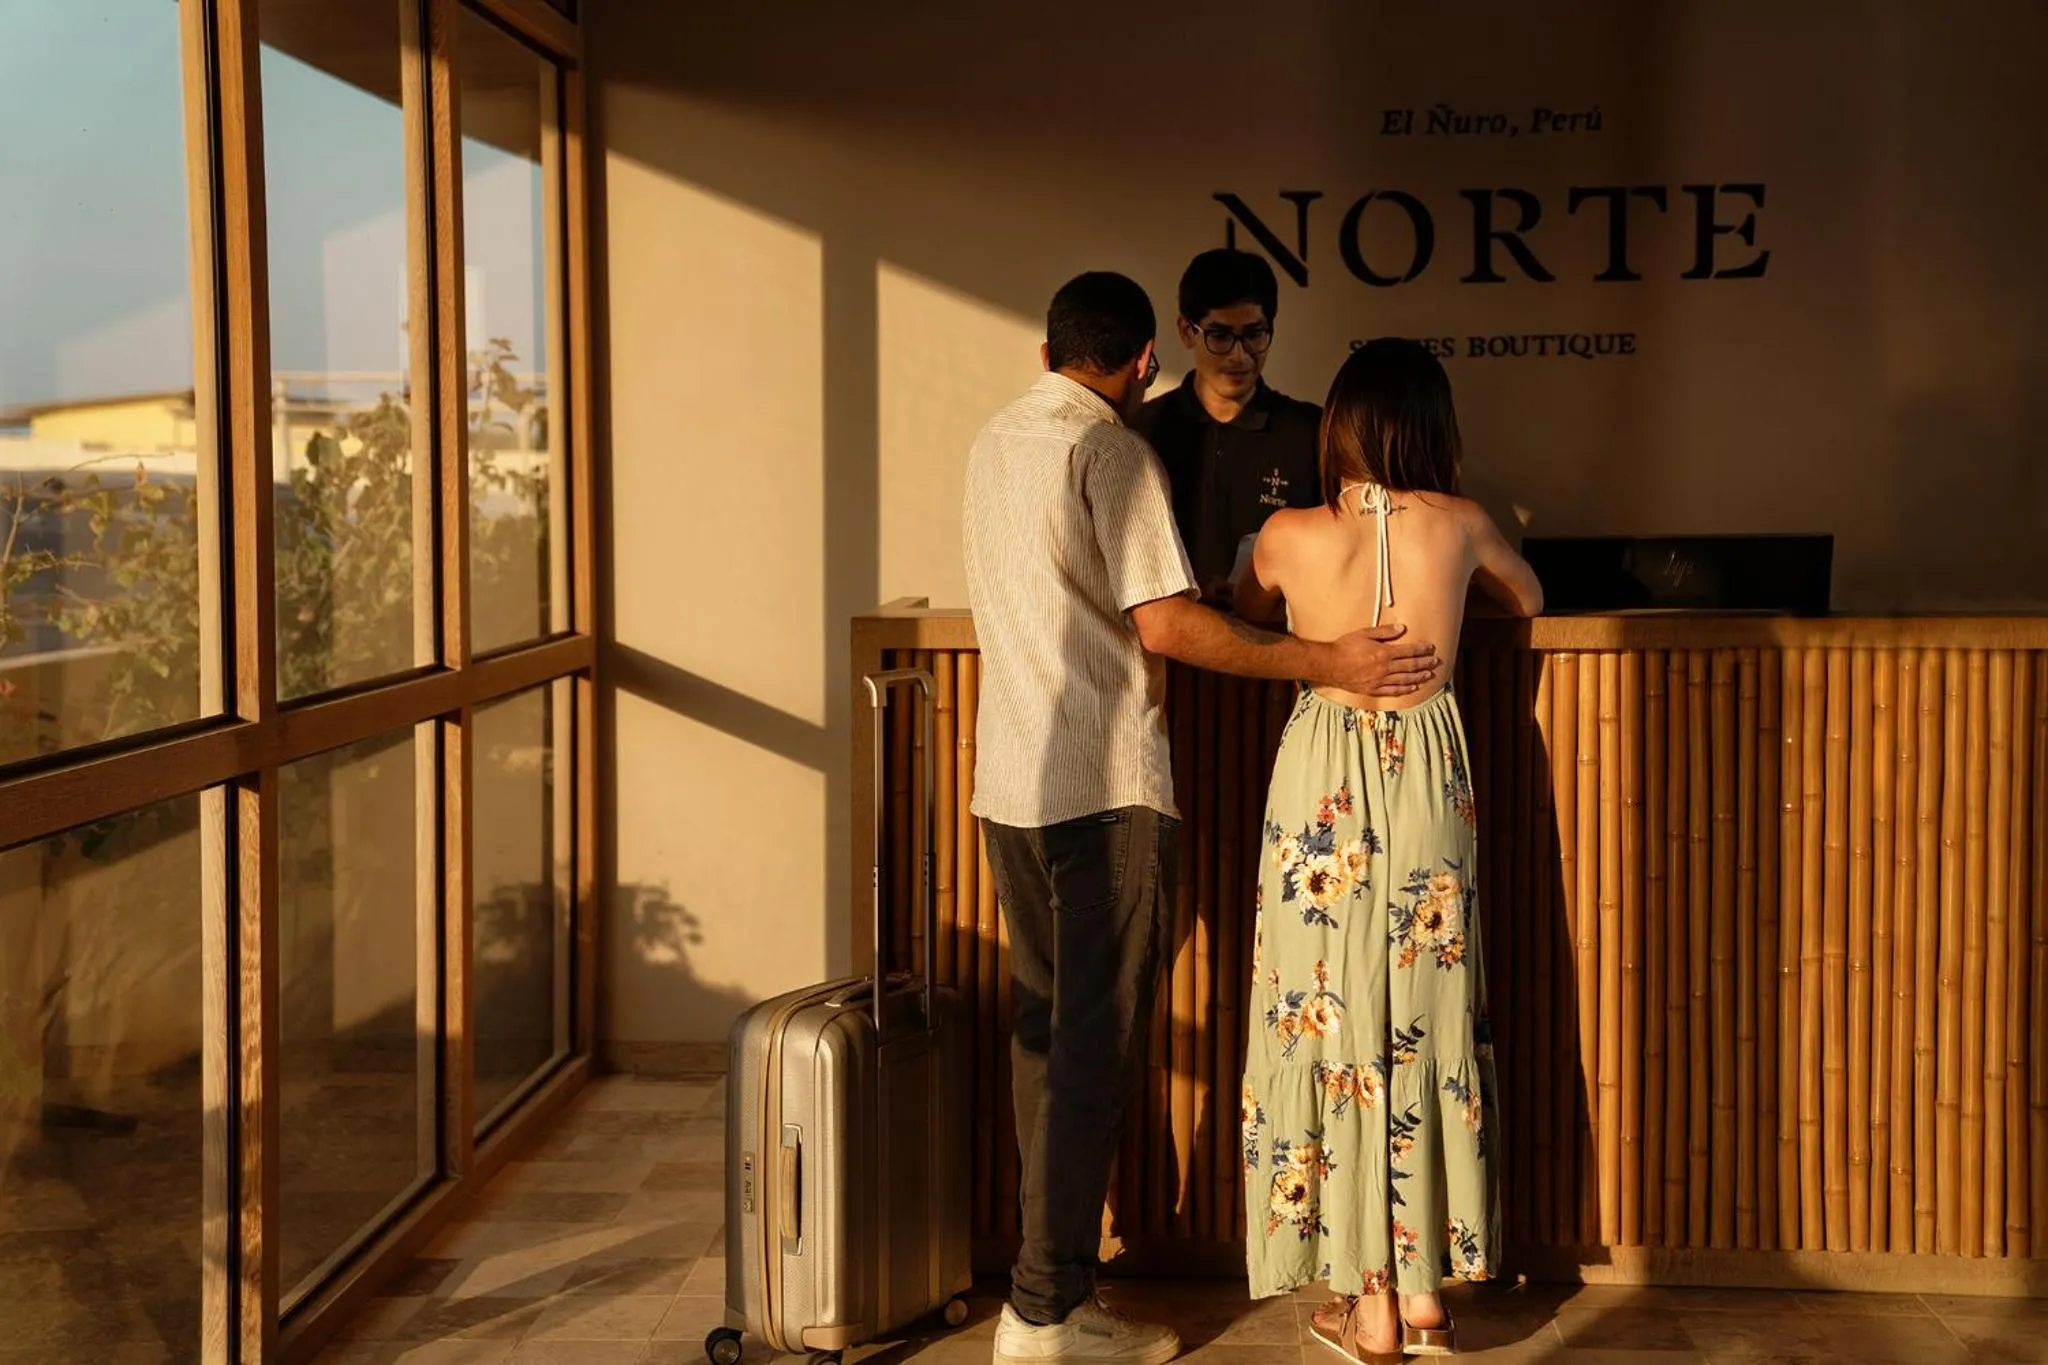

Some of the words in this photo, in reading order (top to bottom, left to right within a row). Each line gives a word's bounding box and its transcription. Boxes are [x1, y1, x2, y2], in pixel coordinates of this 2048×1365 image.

[1381, 109, 1414, 135] El
[1426, 104, 1519, 138] Ñuro,
[1529, 104, 1603, 134] Perú
[1213, 184, 1770, 288] NORTE
[1468, 333, 1637, 359] BOUTIQUE
